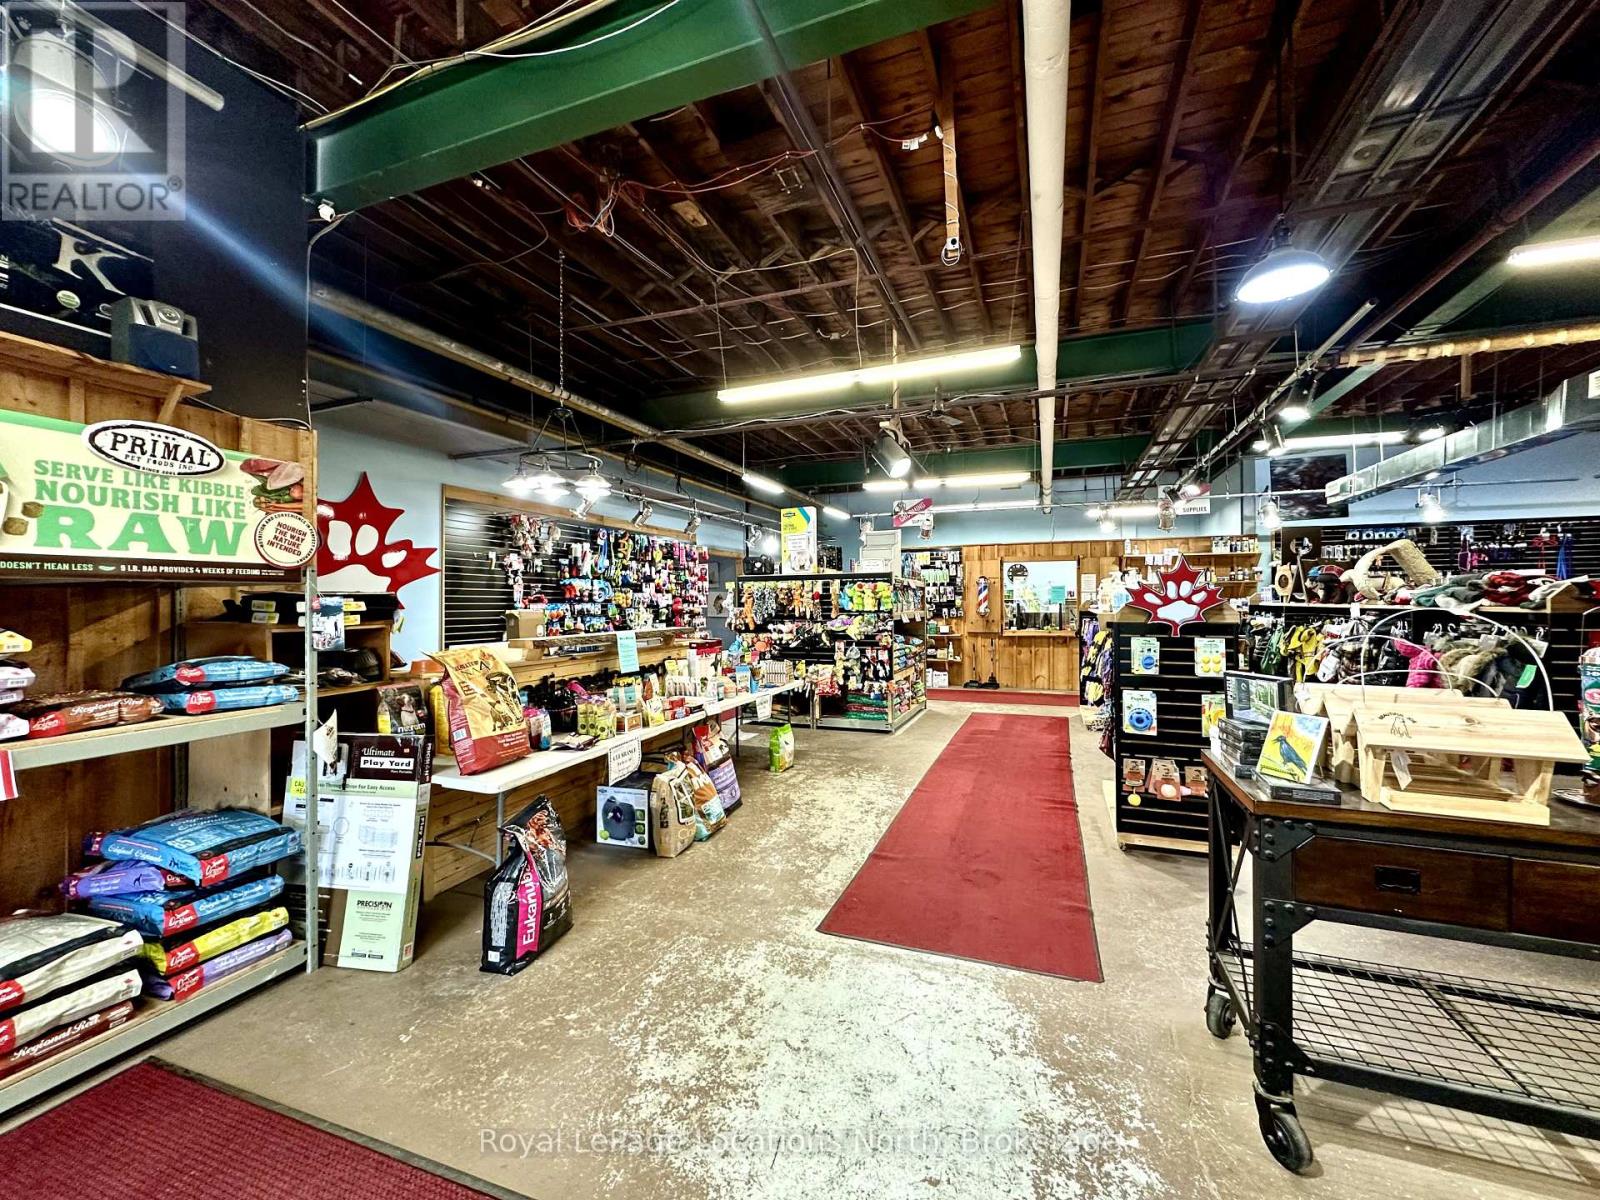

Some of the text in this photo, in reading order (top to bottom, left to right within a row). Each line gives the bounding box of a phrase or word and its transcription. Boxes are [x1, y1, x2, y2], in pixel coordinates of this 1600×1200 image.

[110, 431, 212, 467] PRIMAL
[124, 454, 141, 462] PET
[34, 459, 244, 499] SERVE LIKE KIBBLE
[34, 478, 245, 519] NOURISH LIKE
[33, 504, 248, 557] RAW
[274, 527, 305, 544] THE WAY
[276, 521, 307, 538] NOURISH
[266, 540, 302, 557] INTENDED
[272, 534, 302, 550] NATURE
[0, 560, 94, 572] DOESN'T MEAN LESS
[127, 565, 141, 573] LB.
[142, 565, 158, 573] BAG
[159, 566, 195, 574] PROVIDES
[202, 567, 226, 575] WEEKS
[235, 568, 261, 576] FEEDING
[361, 746, 395, 757] Ultimate
[363, 759, 411, 768] Play Yard
